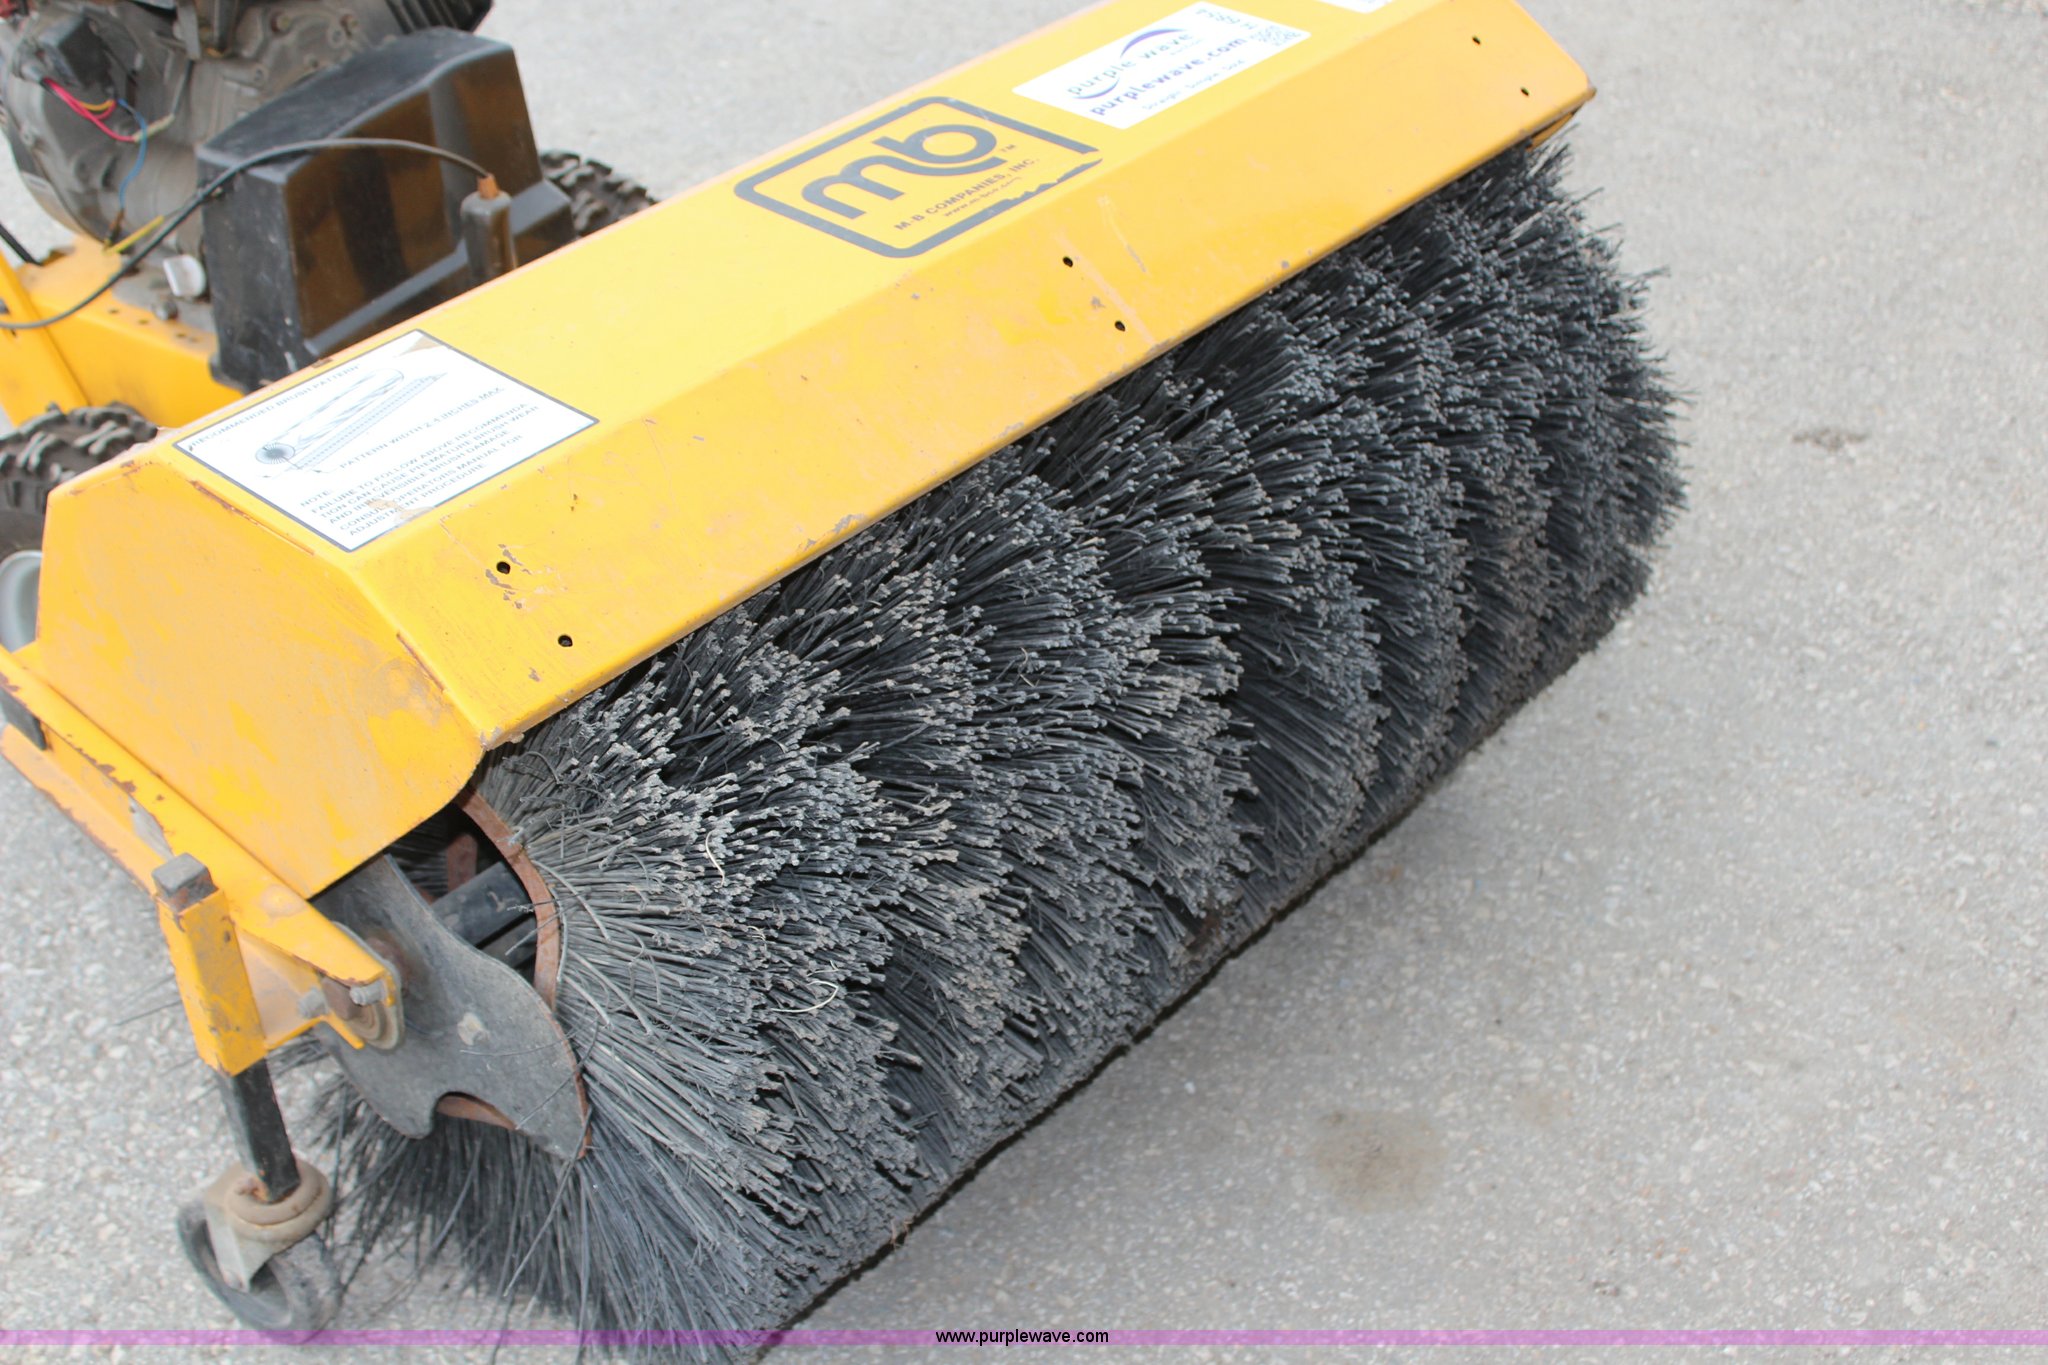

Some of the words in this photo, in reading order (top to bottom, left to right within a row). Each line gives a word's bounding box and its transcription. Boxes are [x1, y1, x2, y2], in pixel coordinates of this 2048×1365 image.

[1067, 58, 1136, 97] purple
[1140, 32, 1194, 60] wave
[1090, 37, 1247, 115] purplewave.com
[310, 489, 357, 513] FAILURE
[373, 458, 418, 481] FOLLOW
[418, 440, 454, 458] ABOVE
[320, 504, 347, 517] TION
[347, 491, 371, 503] CAN
[371, 472, 408, 491] CAUSE
[408, 440, 472, 472] PREMATURE
[472, 421, 509, 439] BRUSH
[509, 406, 539, 420] WEAR
[328, 510, 353, 523] AND
[428, 452, 466, 471] BRUSH
[465, 430, 510, 452] DAMAGE
[339, 444, 389, 468] PATTERN
[388, 426, 424, 443] WIDTH
[339, 502, 393, 529] CONSULT
[455, 447, 499, 469] MANUAL
[499, 435, 523, 446] FOR
[348, 497, 420, 535] ADJUSTMENT
